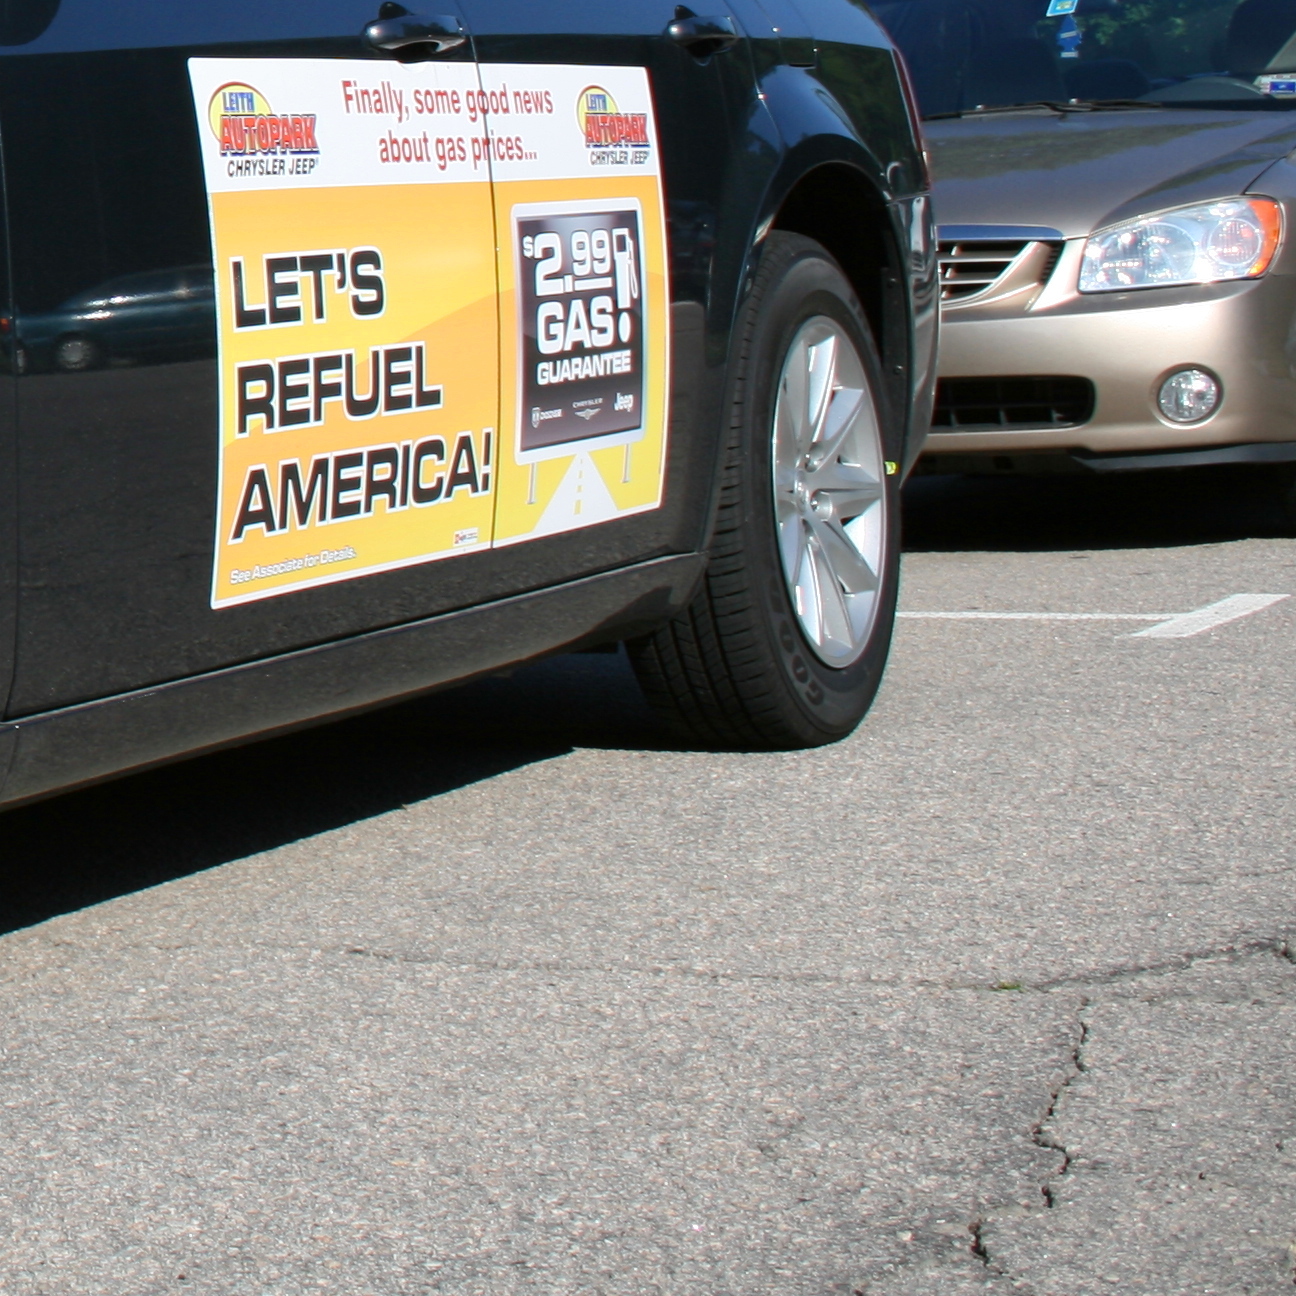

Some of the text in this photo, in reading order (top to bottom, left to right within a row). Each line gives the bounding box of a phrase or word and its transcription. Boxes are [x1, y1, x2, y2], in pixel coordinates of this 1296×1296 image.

[222, 91, 255, 113] LEITH
[341, 80, 554, 123] Finally, some good news
[219, 113, 320, 157] AUTOPARK
[584, 112, 651, 148] AUTOPARK
[227, 157, 316, 177] CHRYSLER JEEP
[379, 129, 538, 171] about gas prices...
[231, 248, 385, 329] LET'S
[537, 350, 631, 385] GUARANTEE
[236, 344, 442, 435] REFUEL
[613, 392, 634, 412] Jeep
[230, 431, 493, 541] AMERICA!
[229, 569, 251, 585] See
[252, 556, 306, 579] Associate
[305, 553, 320, 569] for
